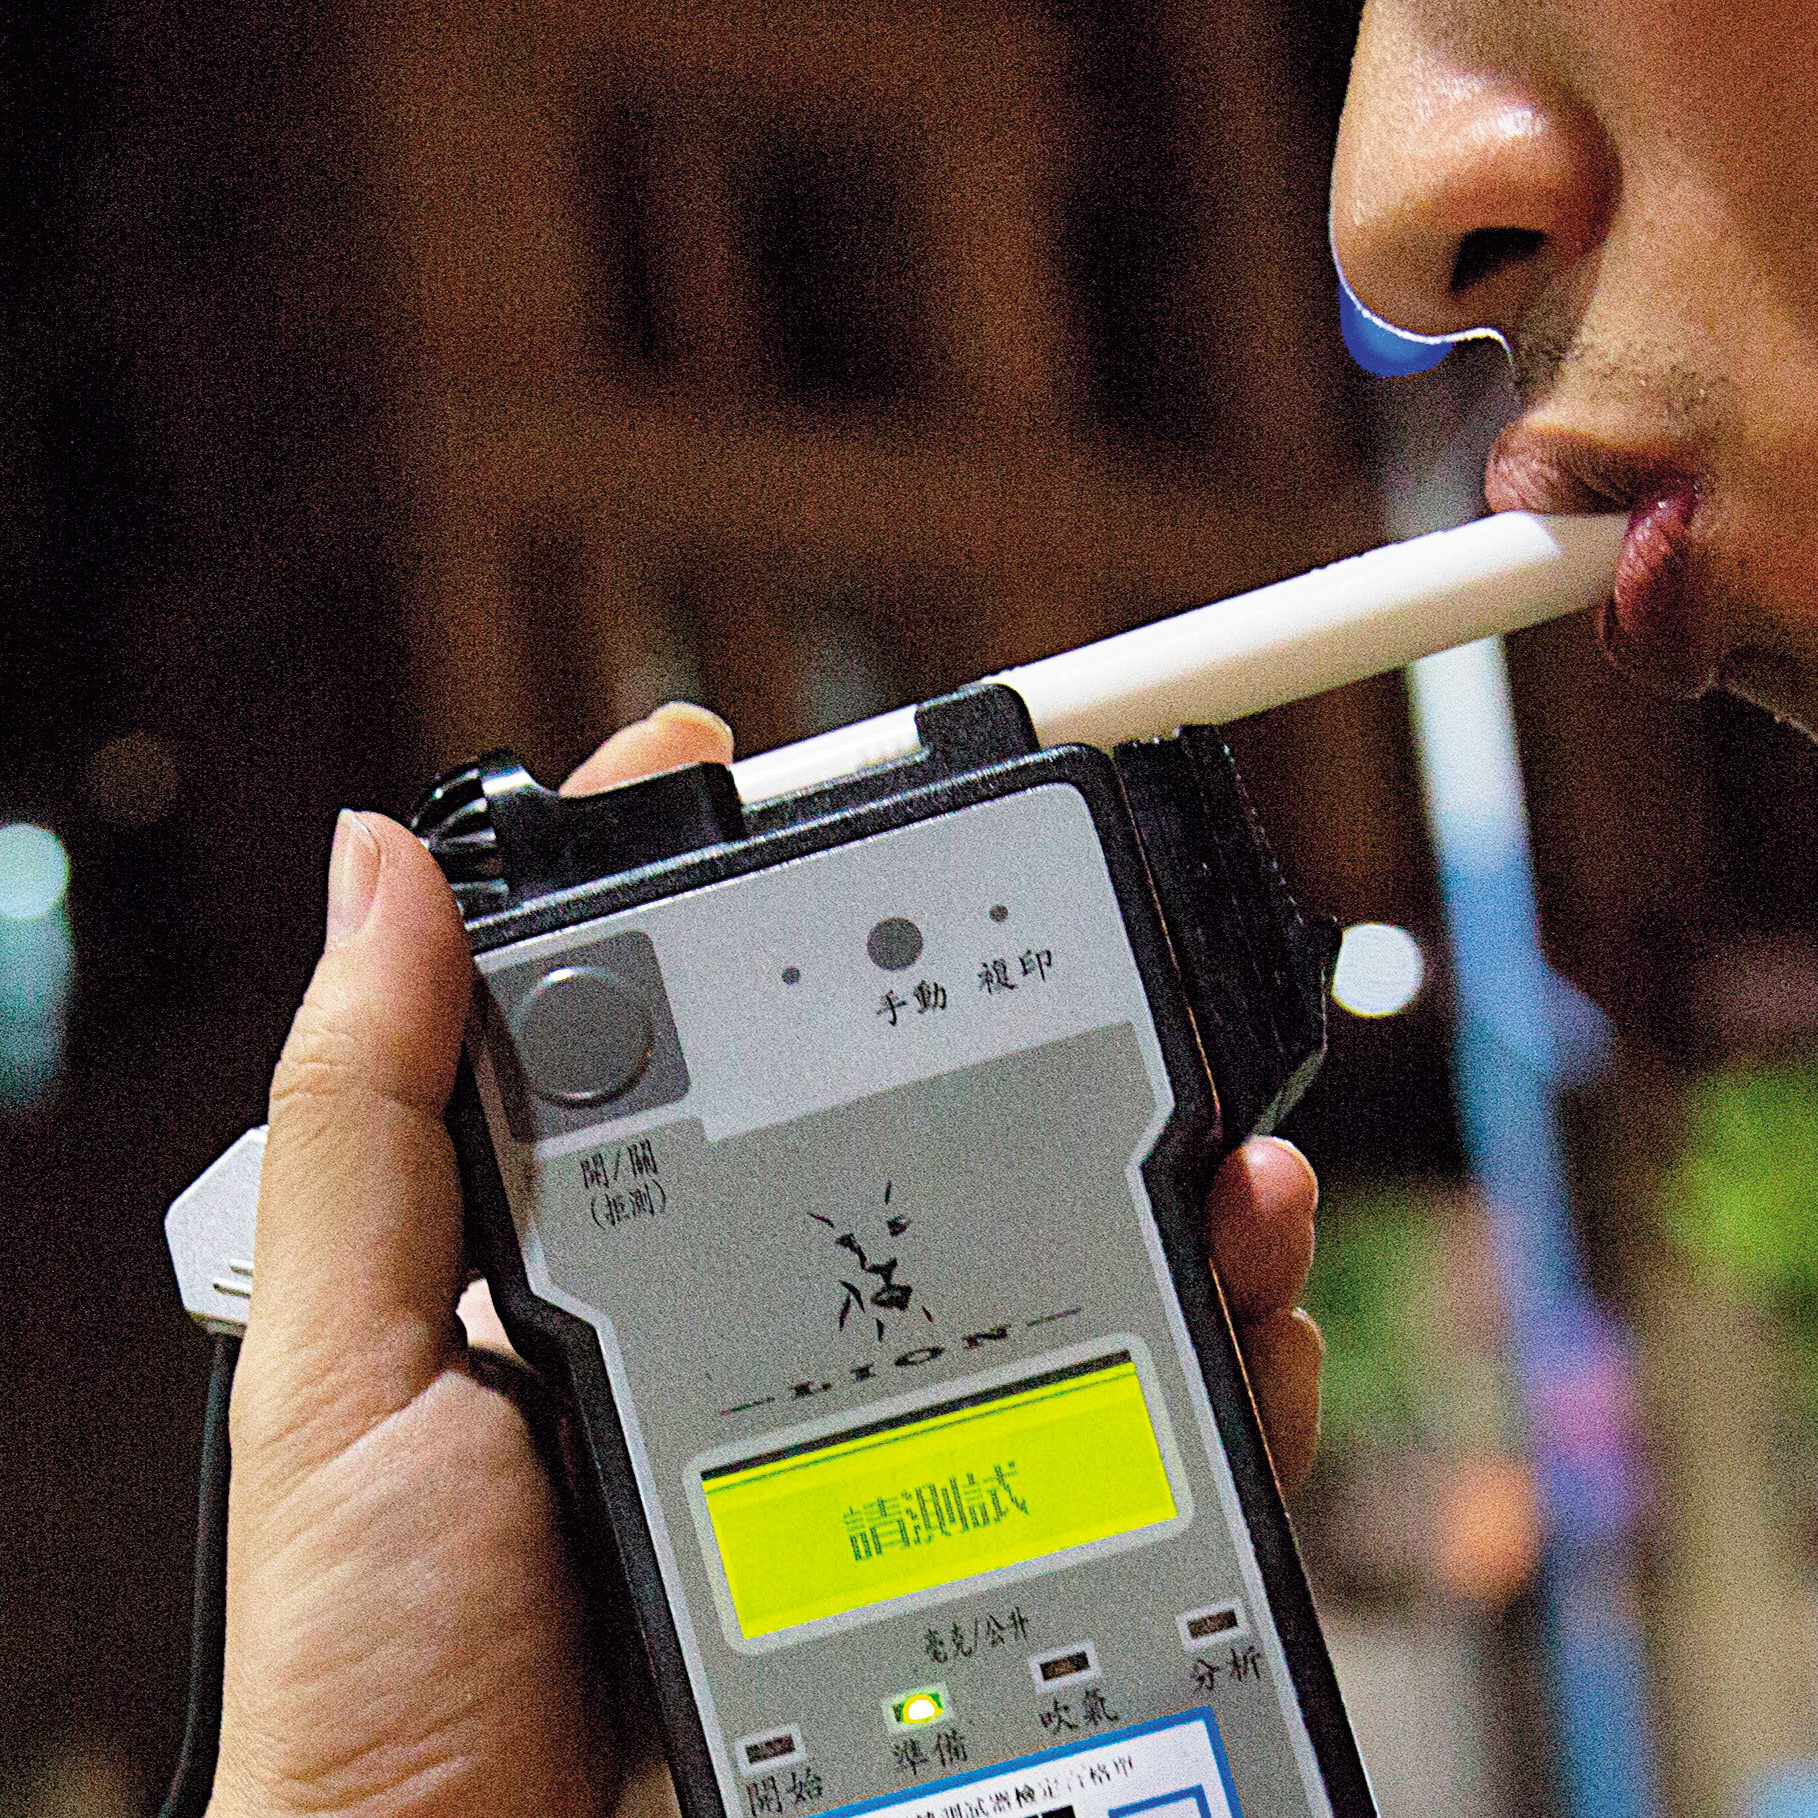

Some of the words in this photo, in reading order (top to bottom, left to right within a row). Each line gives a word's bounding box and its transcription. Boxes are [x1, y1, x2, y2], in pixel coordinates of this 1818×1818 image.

[978, 950, 1052, 994] 複印
[876, 980, 947, 1026] 手動
[791, 1324, 1012, 1397] LION
[843, 1461, 1030, 1561] 請測試
[924, 1605, 1030, 1664] 毫克/公升
[1189, 1648, 1263, 1692] 分析
[1039, 1689, 1120, 1735] 吹氣
[893, 1728, 969, 1776] 準備
[745, 1767, 823, 1818] 開始
